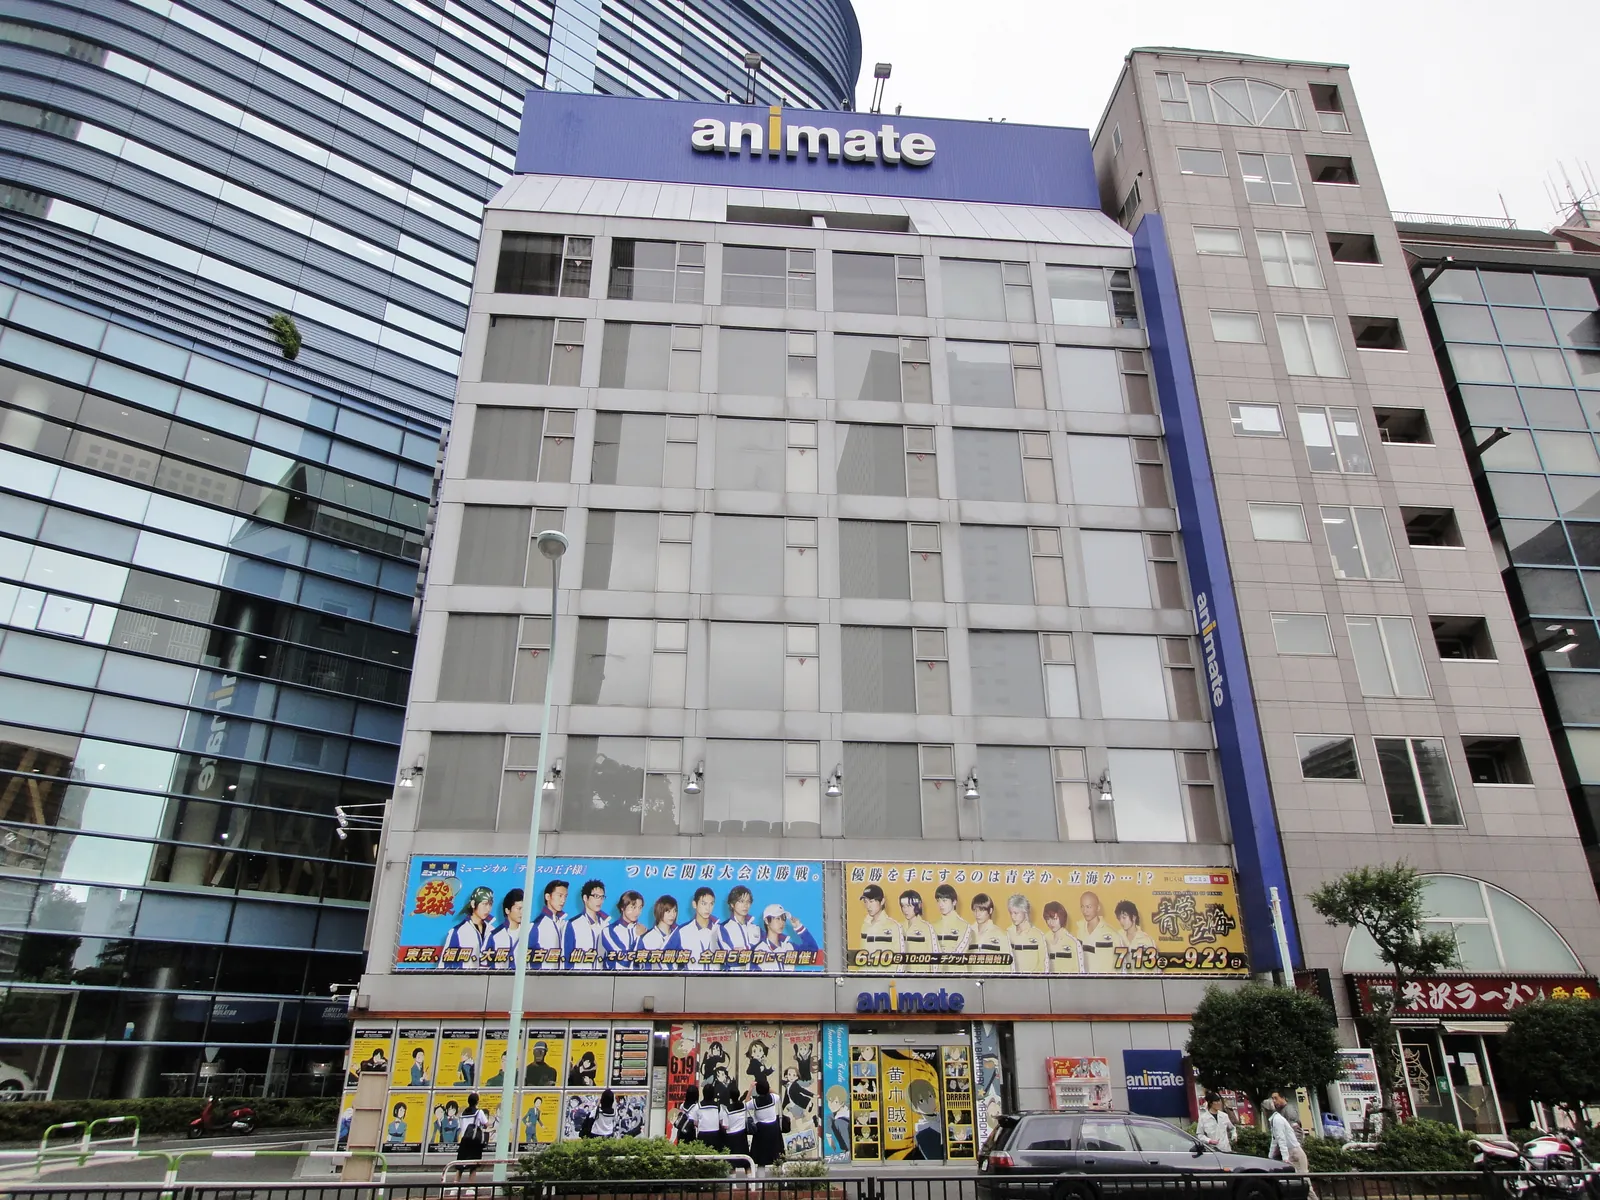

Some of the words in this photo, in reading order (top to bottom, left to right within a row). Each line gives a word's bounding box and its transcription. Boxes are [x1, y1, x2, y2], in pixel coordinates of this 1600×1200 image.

[691, 106, 936, 166] animate
[1197, 592, 1223, 707] animate
[421, 869, 456, 877] ミュージカル
[459, 864, 508, 875] ミュージカル
[513, 865, 588, 876] 『テスの王子様』
[626, 864, 820, 881] ついに関東大会決勝戦。
[413, 896, 455, 916] 王子様
[856, 980, 965, 1013] animate
[671, 1056, 694, 1075] 6.19
[975, 1047, 985, 1087] BIRTHDAY
[1126, 1070, 1184, 1086] animate
[859, 1101, 872, 1109] KIDA
[886, 1066, 907, 1124] 黄巾賊
[978, 1099, 988, 1139] MASAOMI
